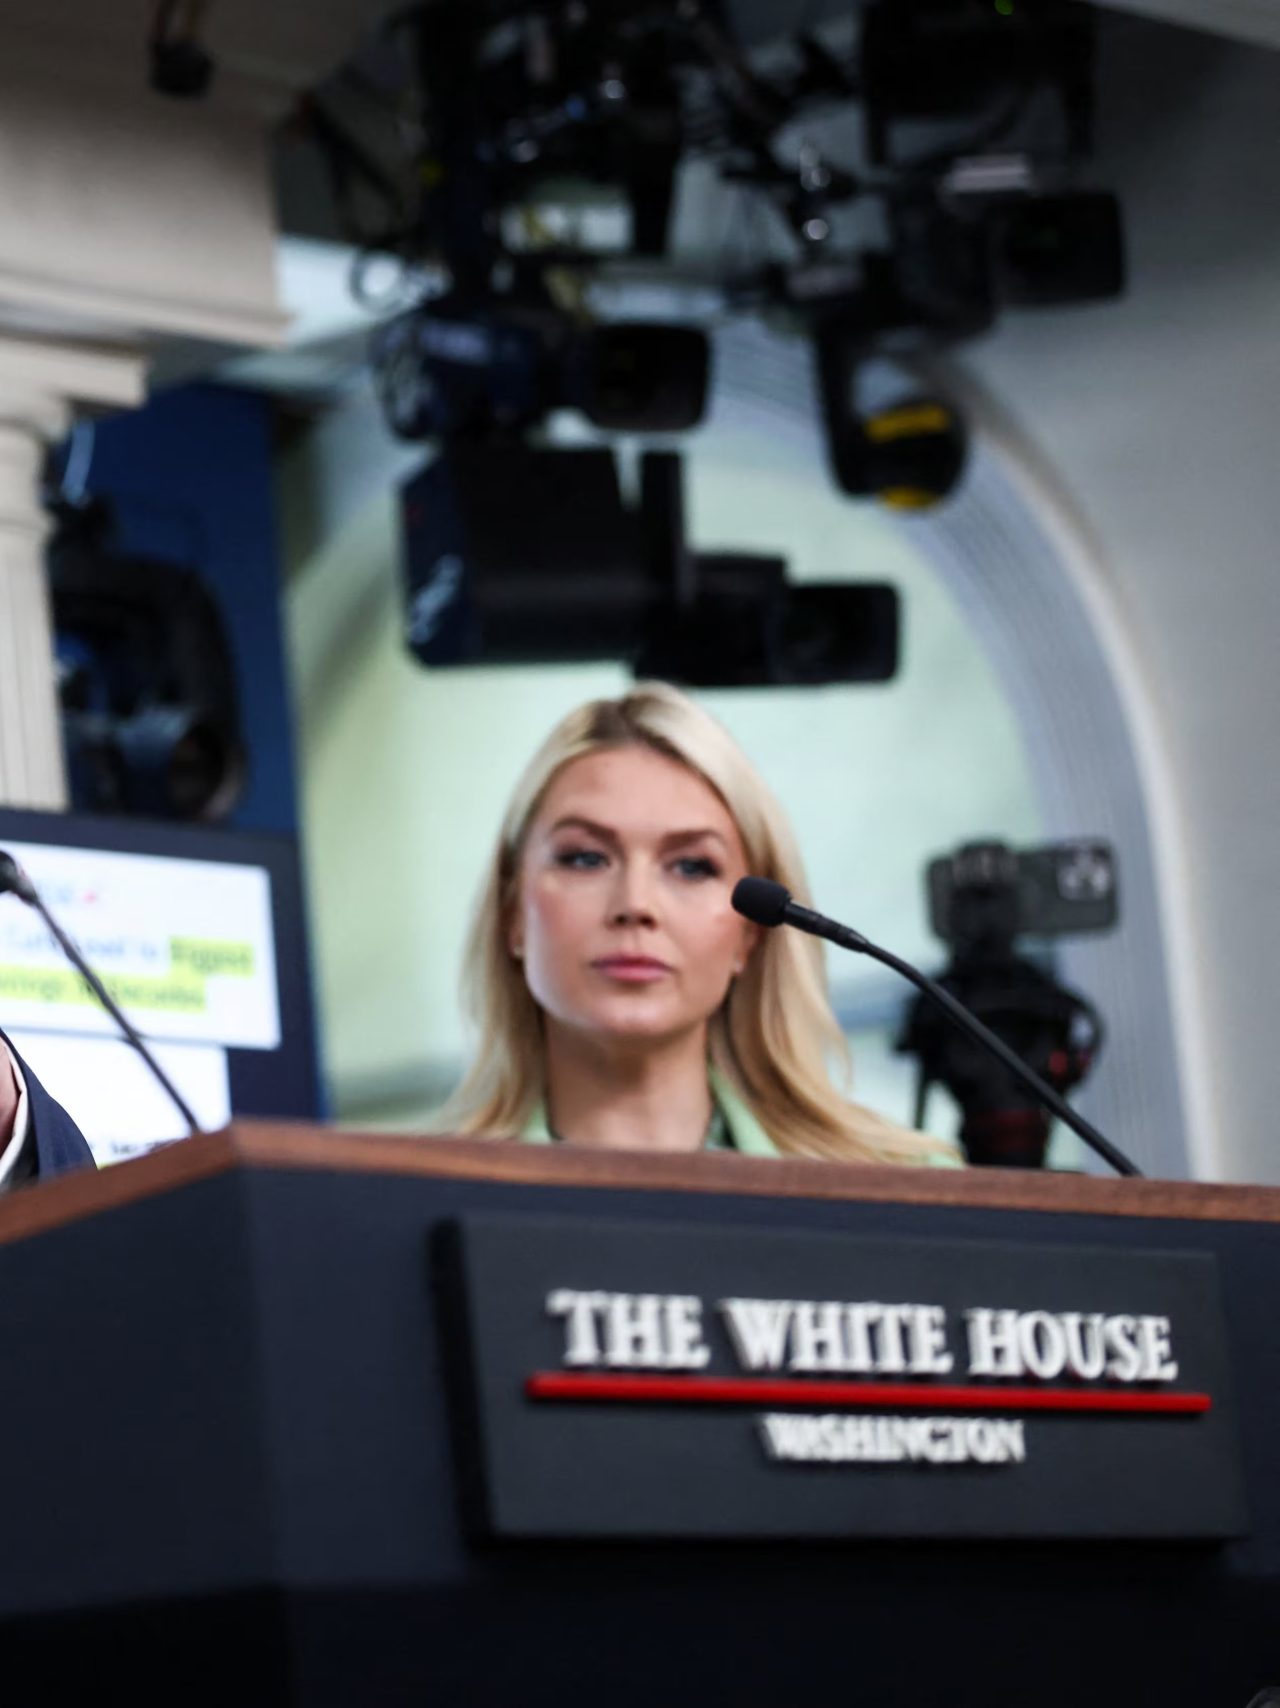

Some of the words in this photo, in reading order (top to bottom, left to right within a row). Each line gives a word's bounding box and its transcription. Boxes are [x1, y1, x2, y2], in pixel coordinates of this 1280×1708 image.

[548, 1289, 711, 1368] THE
[720, 1297, 955, 1374] WHITE
[966, 1307, 1179, 1381] HOUSE
[761, 1412, 1026, 1462] WASHINGTON
